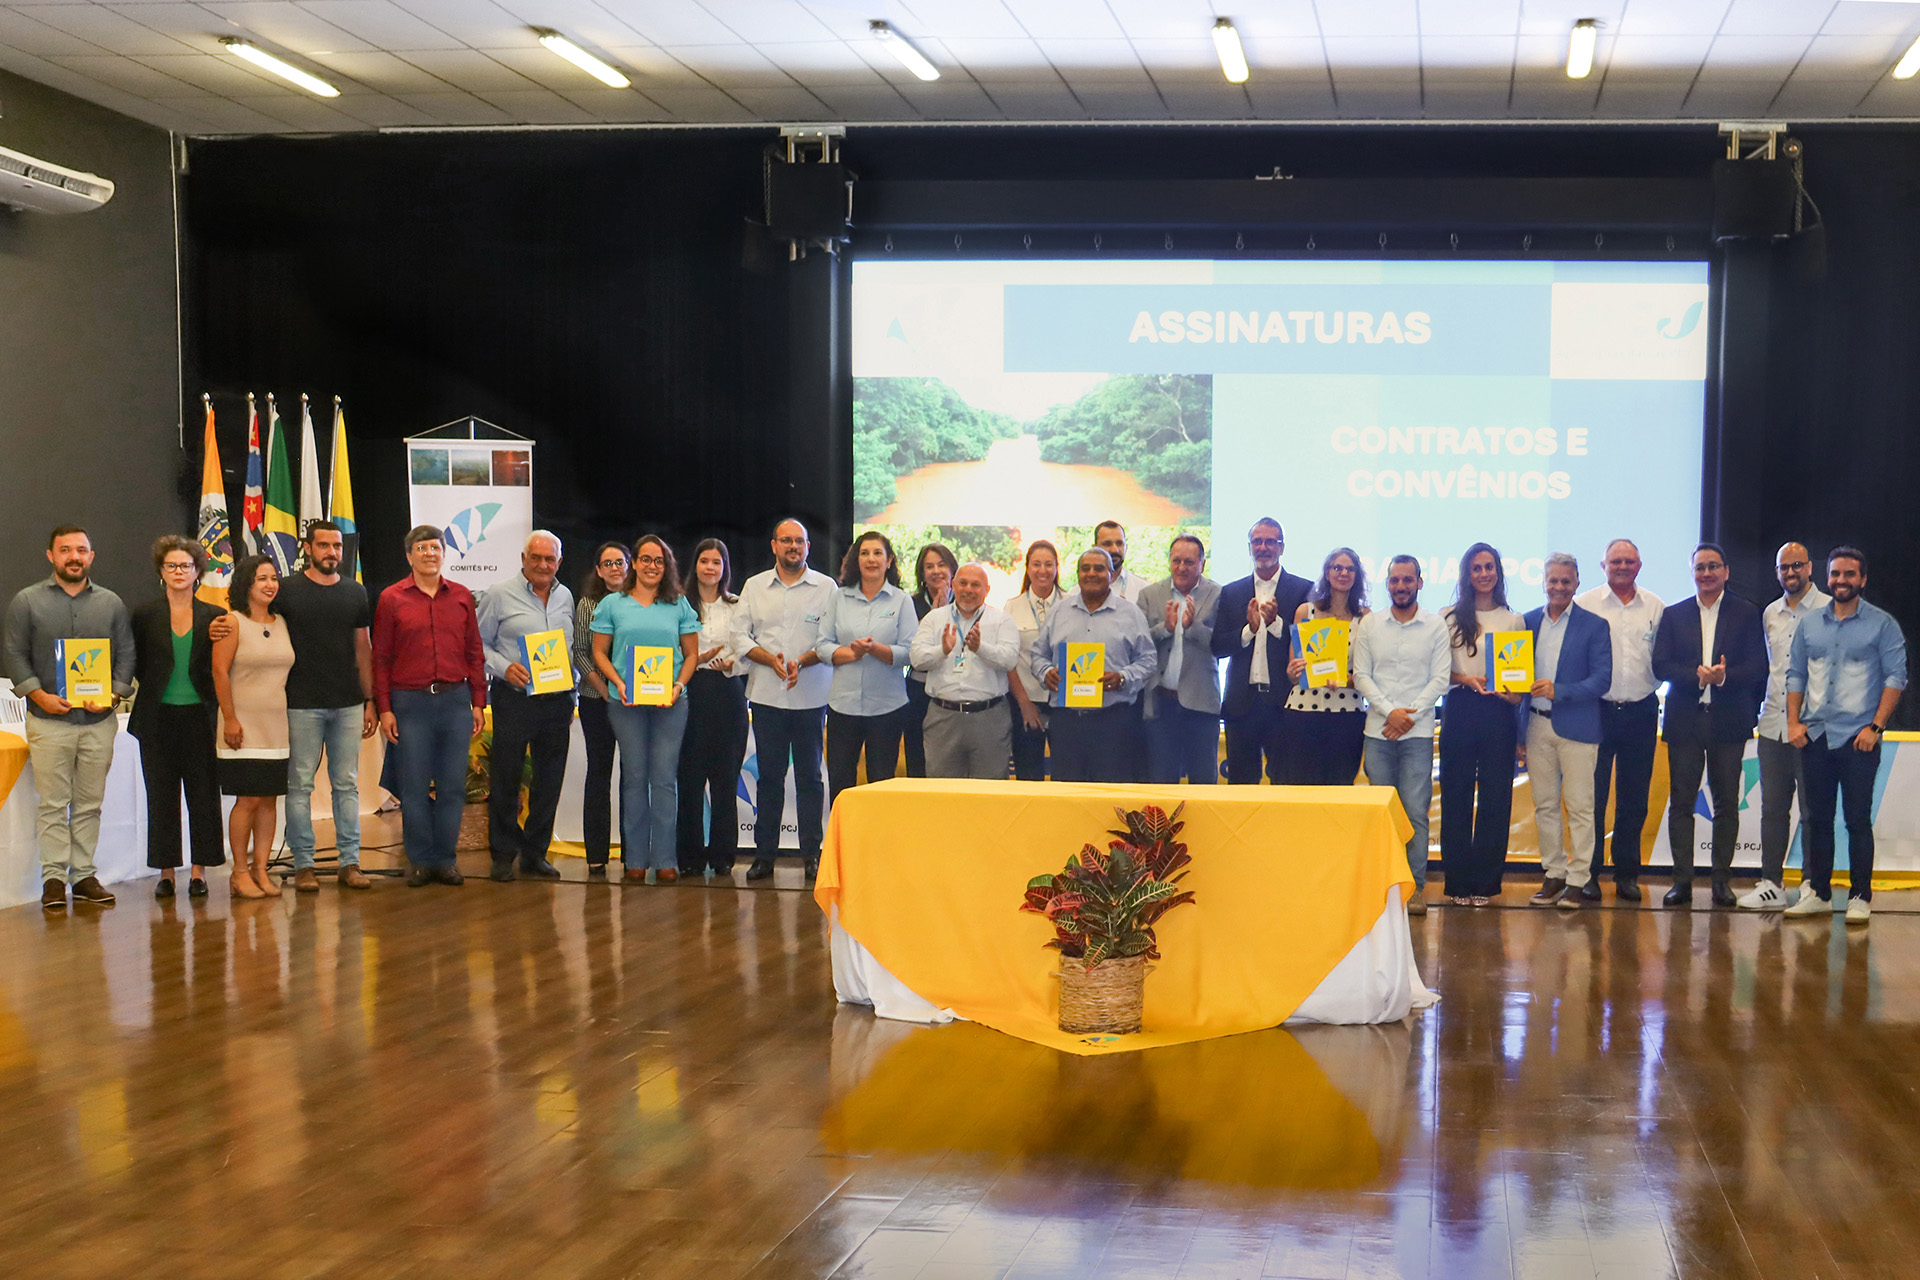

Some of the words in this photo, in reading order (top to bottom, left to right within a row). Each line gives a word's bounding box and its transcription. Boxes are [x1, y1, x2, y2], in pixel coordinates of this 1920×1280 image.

[1128, 311, 1432, 344] ASSINATURAS
[1331, 426, 1558, 456] CONTRATOS
[1567, 427, 1589, 456] E
[1347, 464, 1571, 499] CONVÊNIOS
[450, 563, 482, 572] COMITÊS
